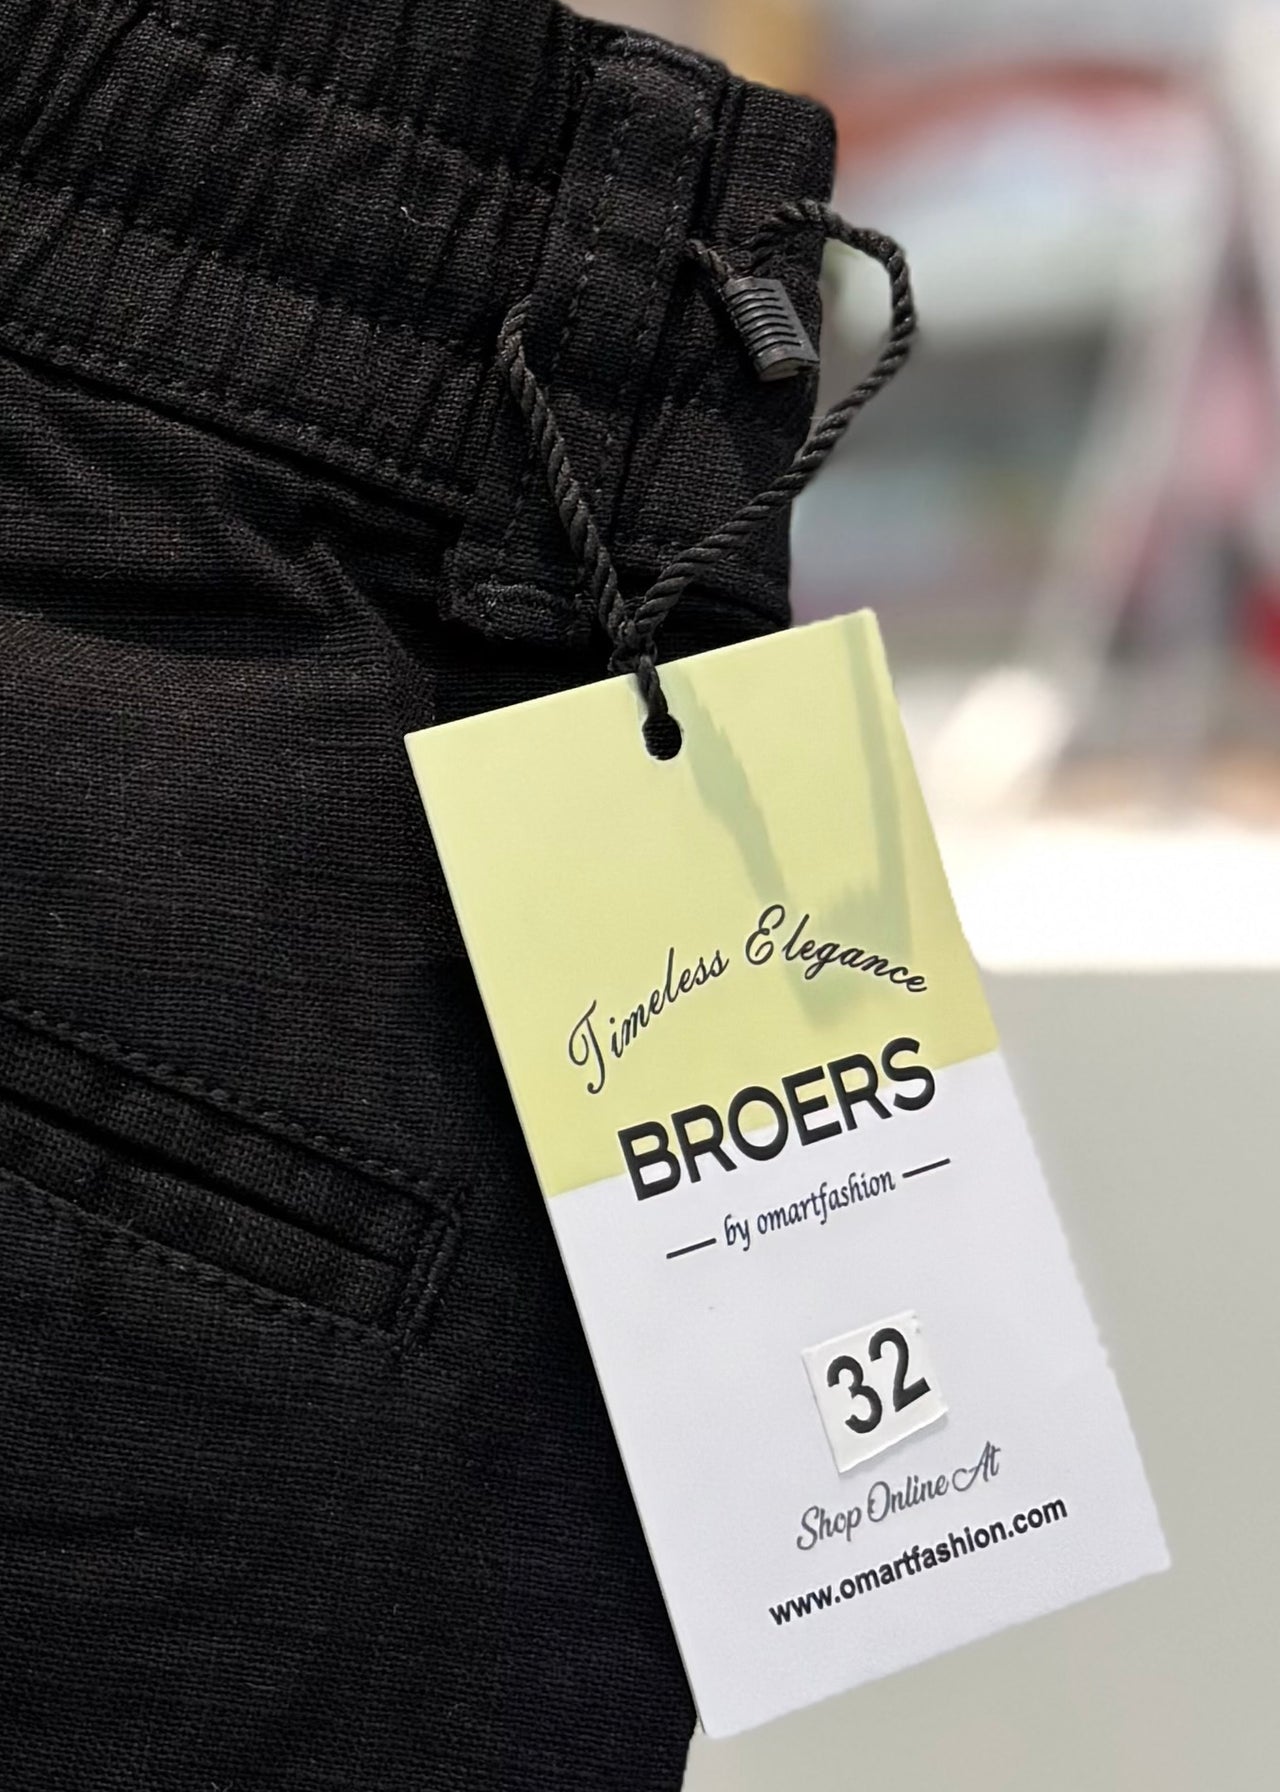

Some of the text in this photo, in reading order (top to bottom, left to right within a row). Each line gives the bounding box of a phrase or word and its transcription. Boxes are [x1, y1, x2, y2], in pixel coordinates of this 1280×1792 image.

[568, 904, 928, 1095] Timeless Elegance
[617, 1036, 936, 1201] BROERS
[724, 1170, 897, 1252] by omartfashion
[827, 1327, 931, 1434] 32
[797, 1440, 1001, 1550] Shop Online At
[768, 1499, 1068, 1625] www.omartfashion.com
